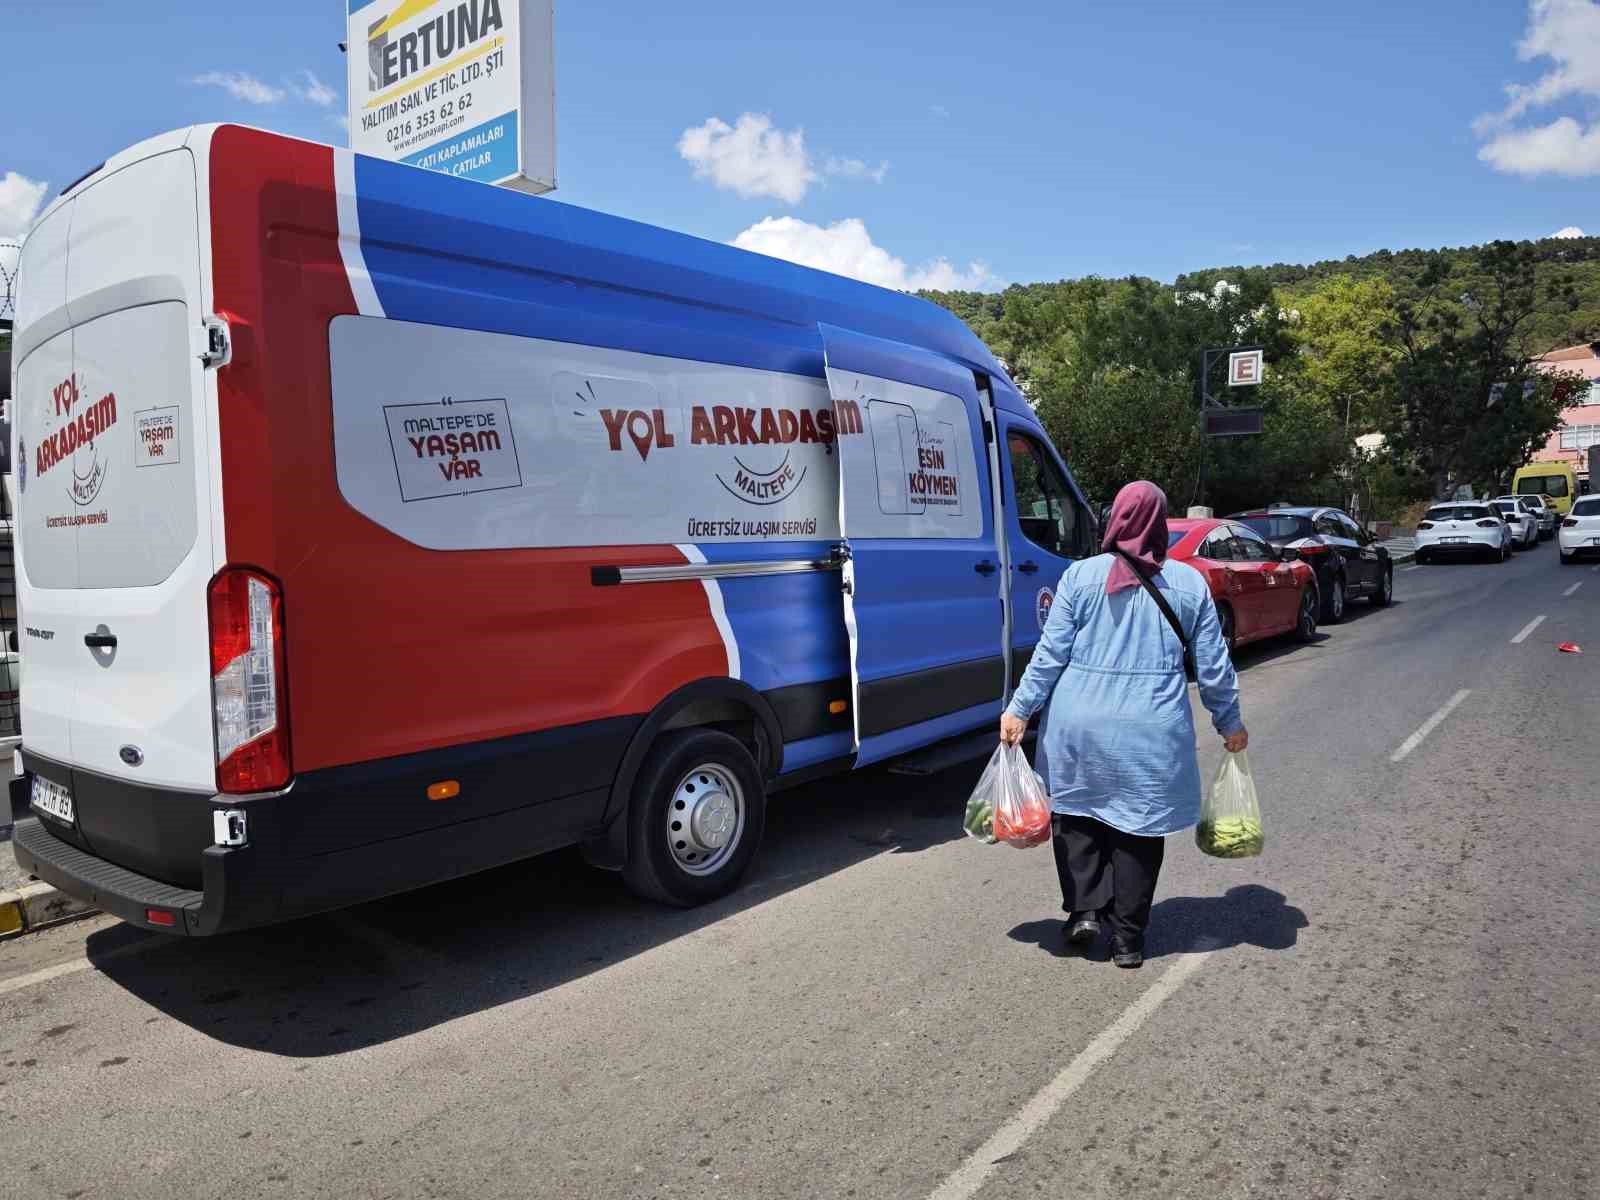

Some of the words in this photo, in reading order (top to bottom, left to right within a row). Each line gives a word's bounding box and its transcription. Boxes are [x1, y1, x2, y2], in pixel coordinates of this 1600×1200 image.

[382, 0, 503, 88] ERTUNA
[362, 102, 398, 132] YALITIM
[400, 90, 423, 114] SAN.
[425, 82, 438, 103] VE
[439, 73, 459, 95] TİC.
[461, 62, 483, 85] LTD.
[386, 121, 412, 143] 0216
[416, 110, 435, 130] 353
[440, 102, 453, 119] 62
[458, 93, 472, 110] 62
[438, 125, 504, 163] KAPLAMALARI
[1237, 359, 1254, 379] E
[53, 373, 79, 417] YOL
[36, 391, 117, 478] ARKADAŞIM
[140, 426, 173, 445] YAŞAM
[404, 413, 497, 434] MALTEPE'DE
[600, 408, 675, 463] YOL
[148, 444, 164, 457] VAR
[408, 430, 502, 460] YAŞAM
[917, 445, 945, 470] ESİN
[438, 459, 483, 481] VAR
[734, 464, 795, 499] MALTEPE
[908, 469, 958, 496] KÖYMEN
[687, 517, 741, 537] ÜCRETSİZ
[742, 519, 780, 538] ULAŞIM
[781, 518, 817, 536] SERVİSİ
